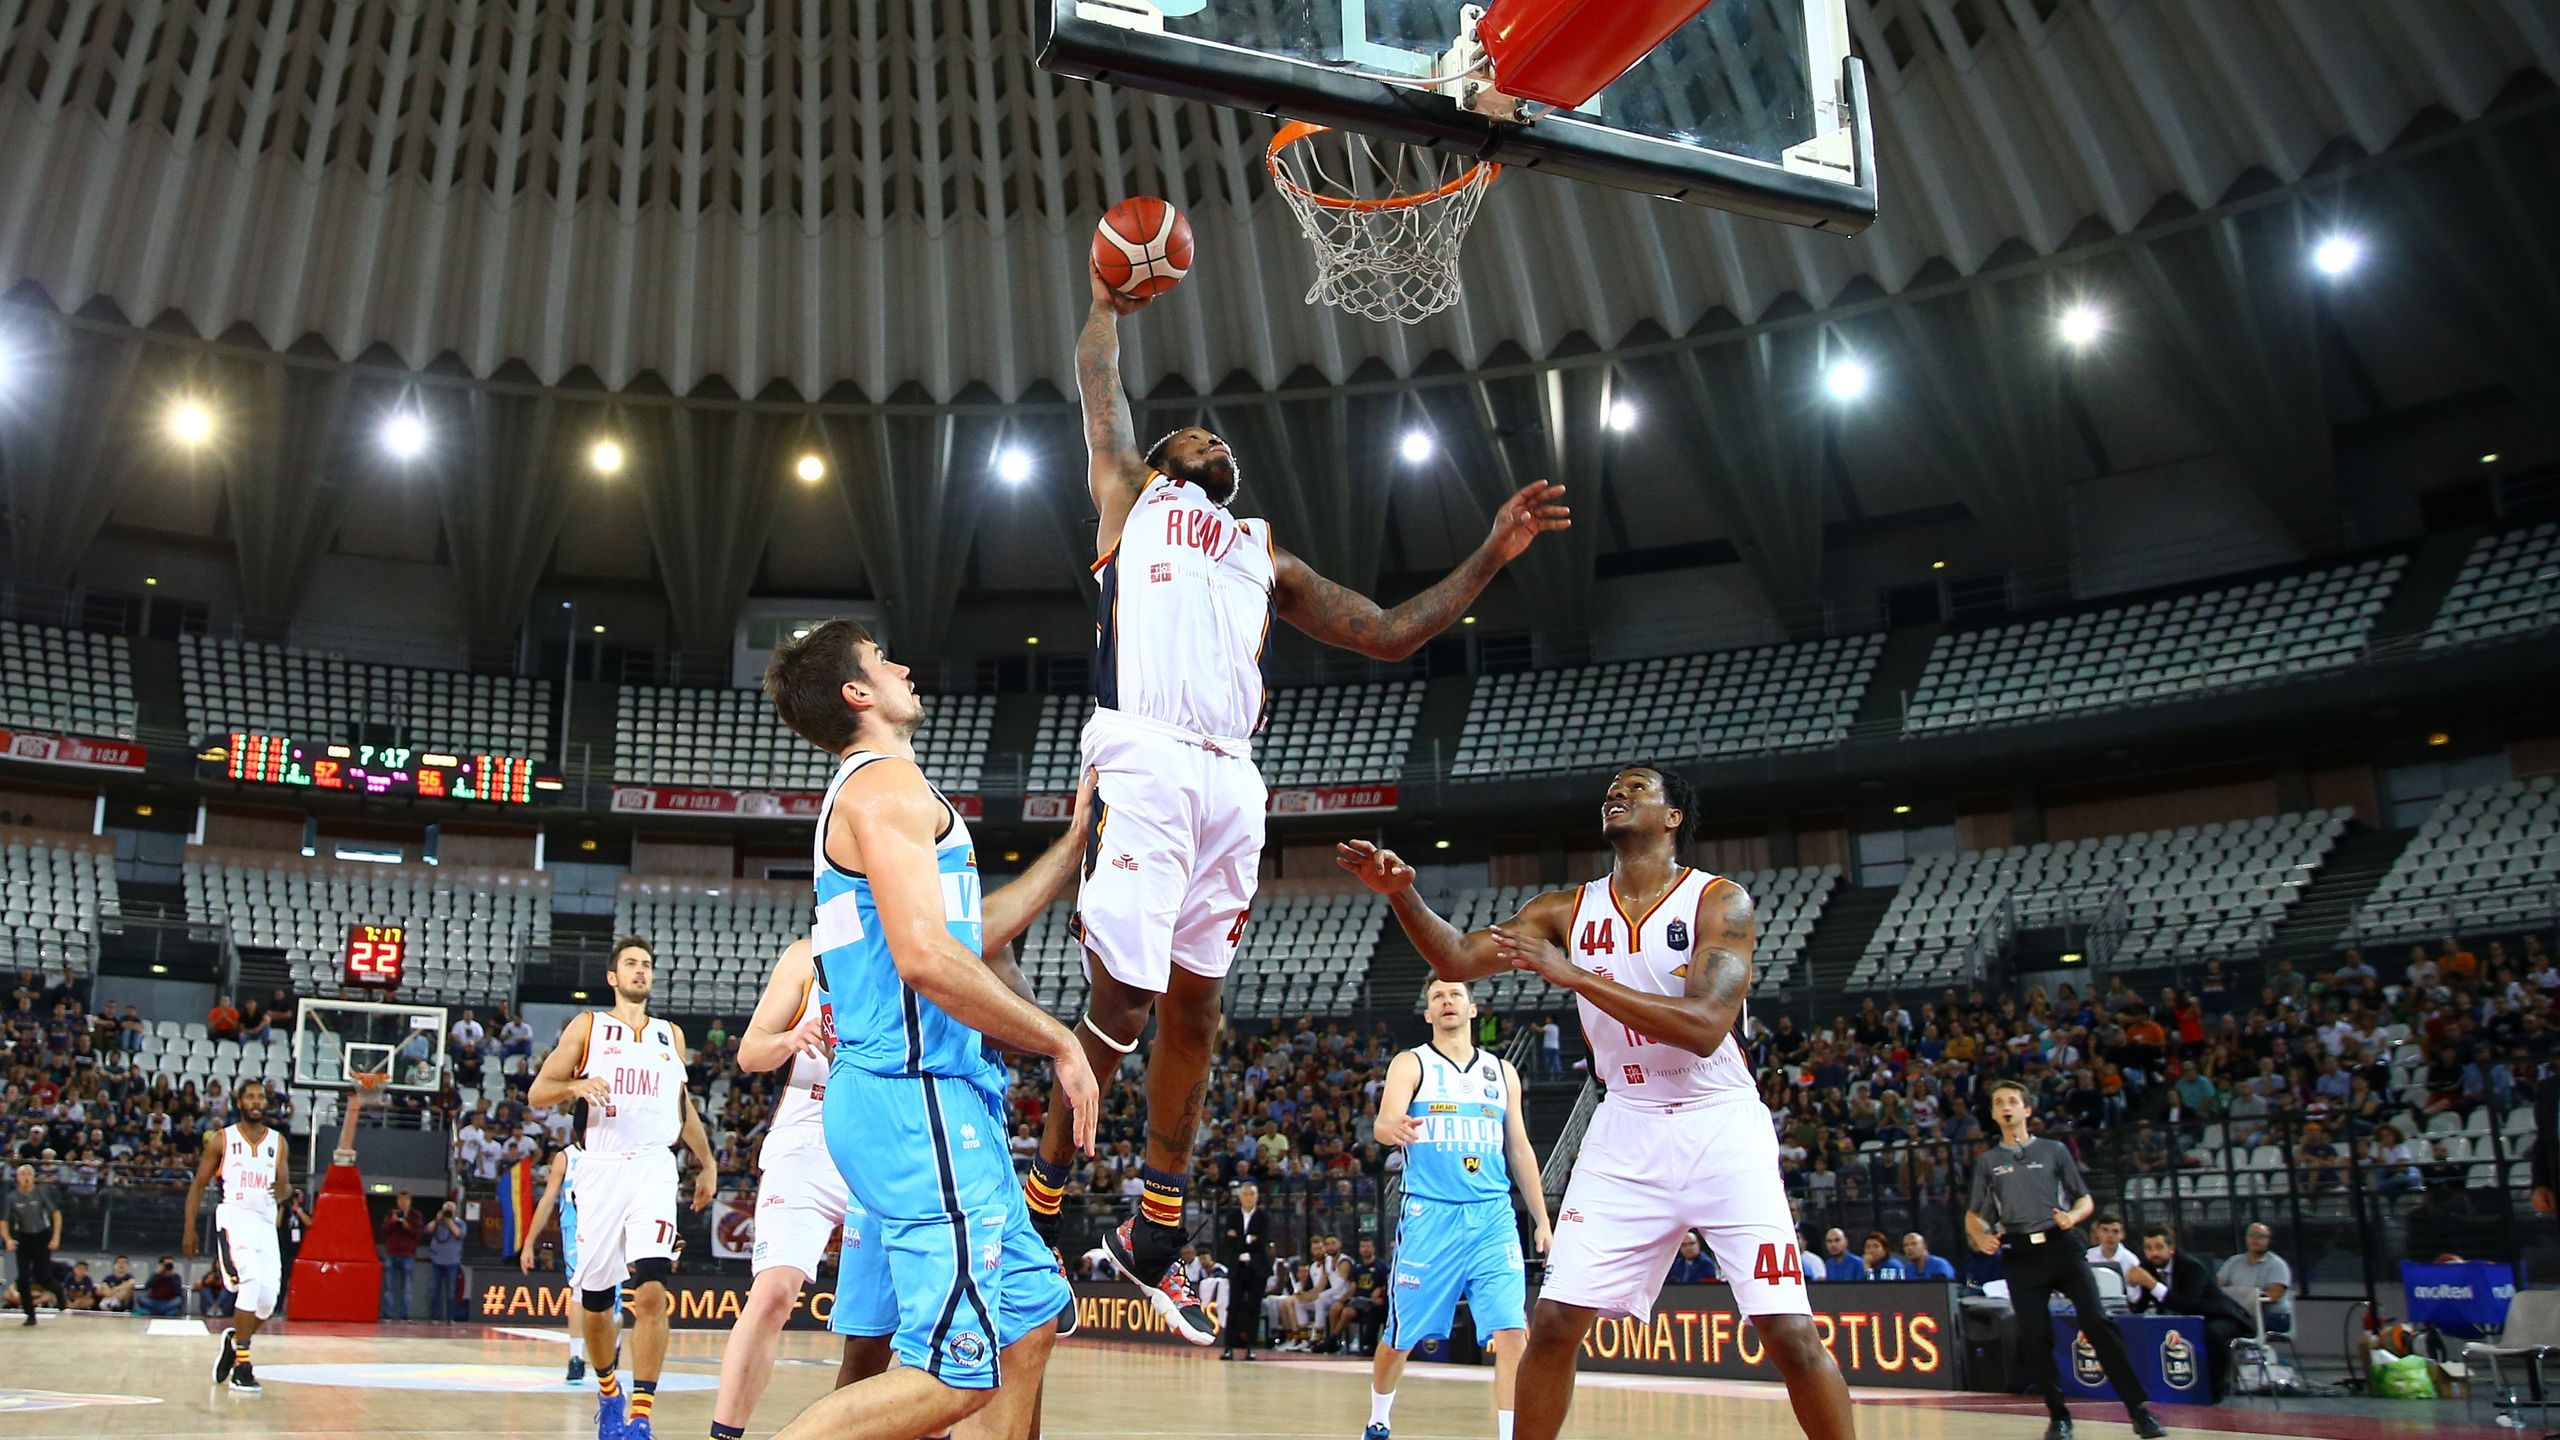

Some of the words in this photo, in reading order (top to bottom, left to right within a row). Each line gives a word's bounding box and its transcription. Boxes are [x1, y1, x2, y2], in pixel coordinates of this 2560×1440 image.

[96, 748, 130, 763] 103.0
[315, 761, 339, 777] 57
[418, 770, 440, 786] 56
[690, 795, 721, 810] 103.0
[1350, 791, 1382, 805] 103.0
[364, 926, 402, 943] 7:17
[1580, 918, 1615, 956] 44
[351, 942, 397, 973] 22
[603, 1024, 622, 1041] 77
[614, 1067, 659, 1098] ROMA
[231, 1142, 243, 1155] 11
[240, 1170, 269, 1189] ROMA
[1146, 1179, 1181, 1193] ROMA
[656, 1219, 675, 1245] 77
[1754, 1243, 1802, 1285] 44
[2167, 1361, 2191, 1374] LBA
